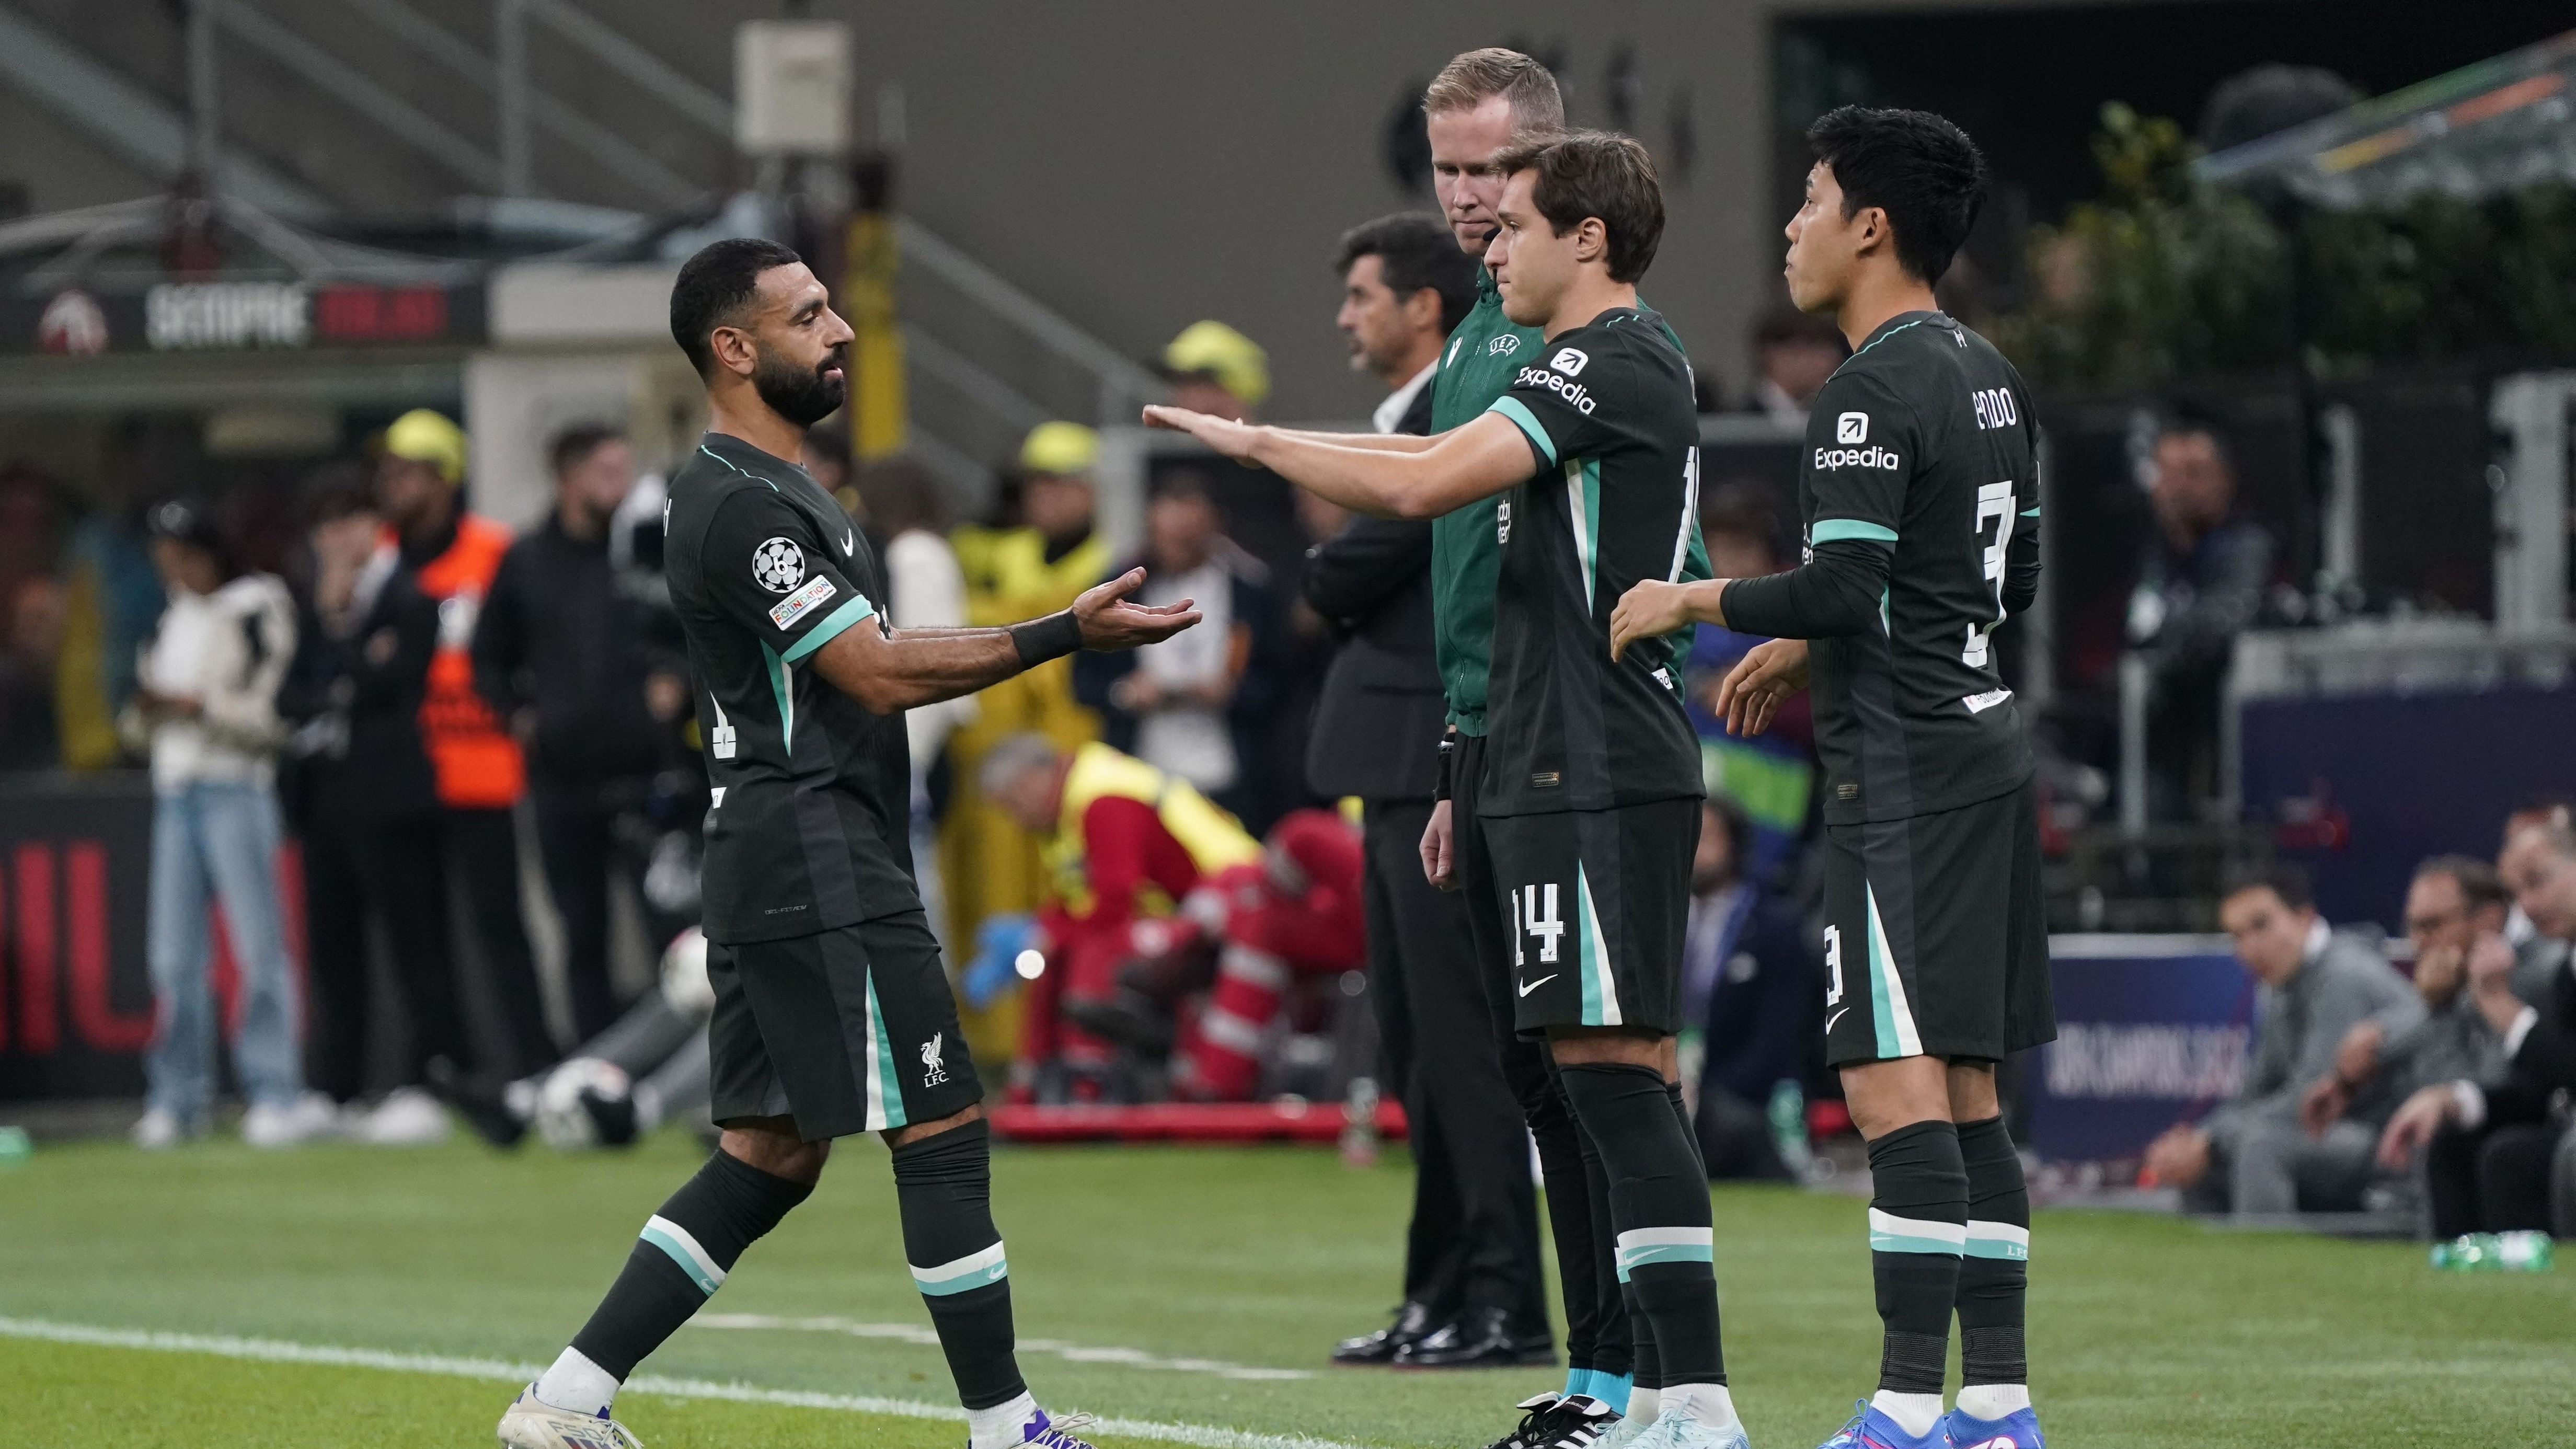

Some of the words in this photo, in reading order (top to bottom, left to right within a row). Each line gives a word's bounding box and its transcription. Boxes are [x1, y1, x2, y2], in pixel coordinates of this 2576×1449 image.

[1490, 337, 1517, 354] UEFA
[1514, 366, 1596, 415] Expedia
[1815, 445, 1899, 471] Expedia
[775, 580, 830, 624] FOUNDATION
[1512, 883, 1565, 968] 14
